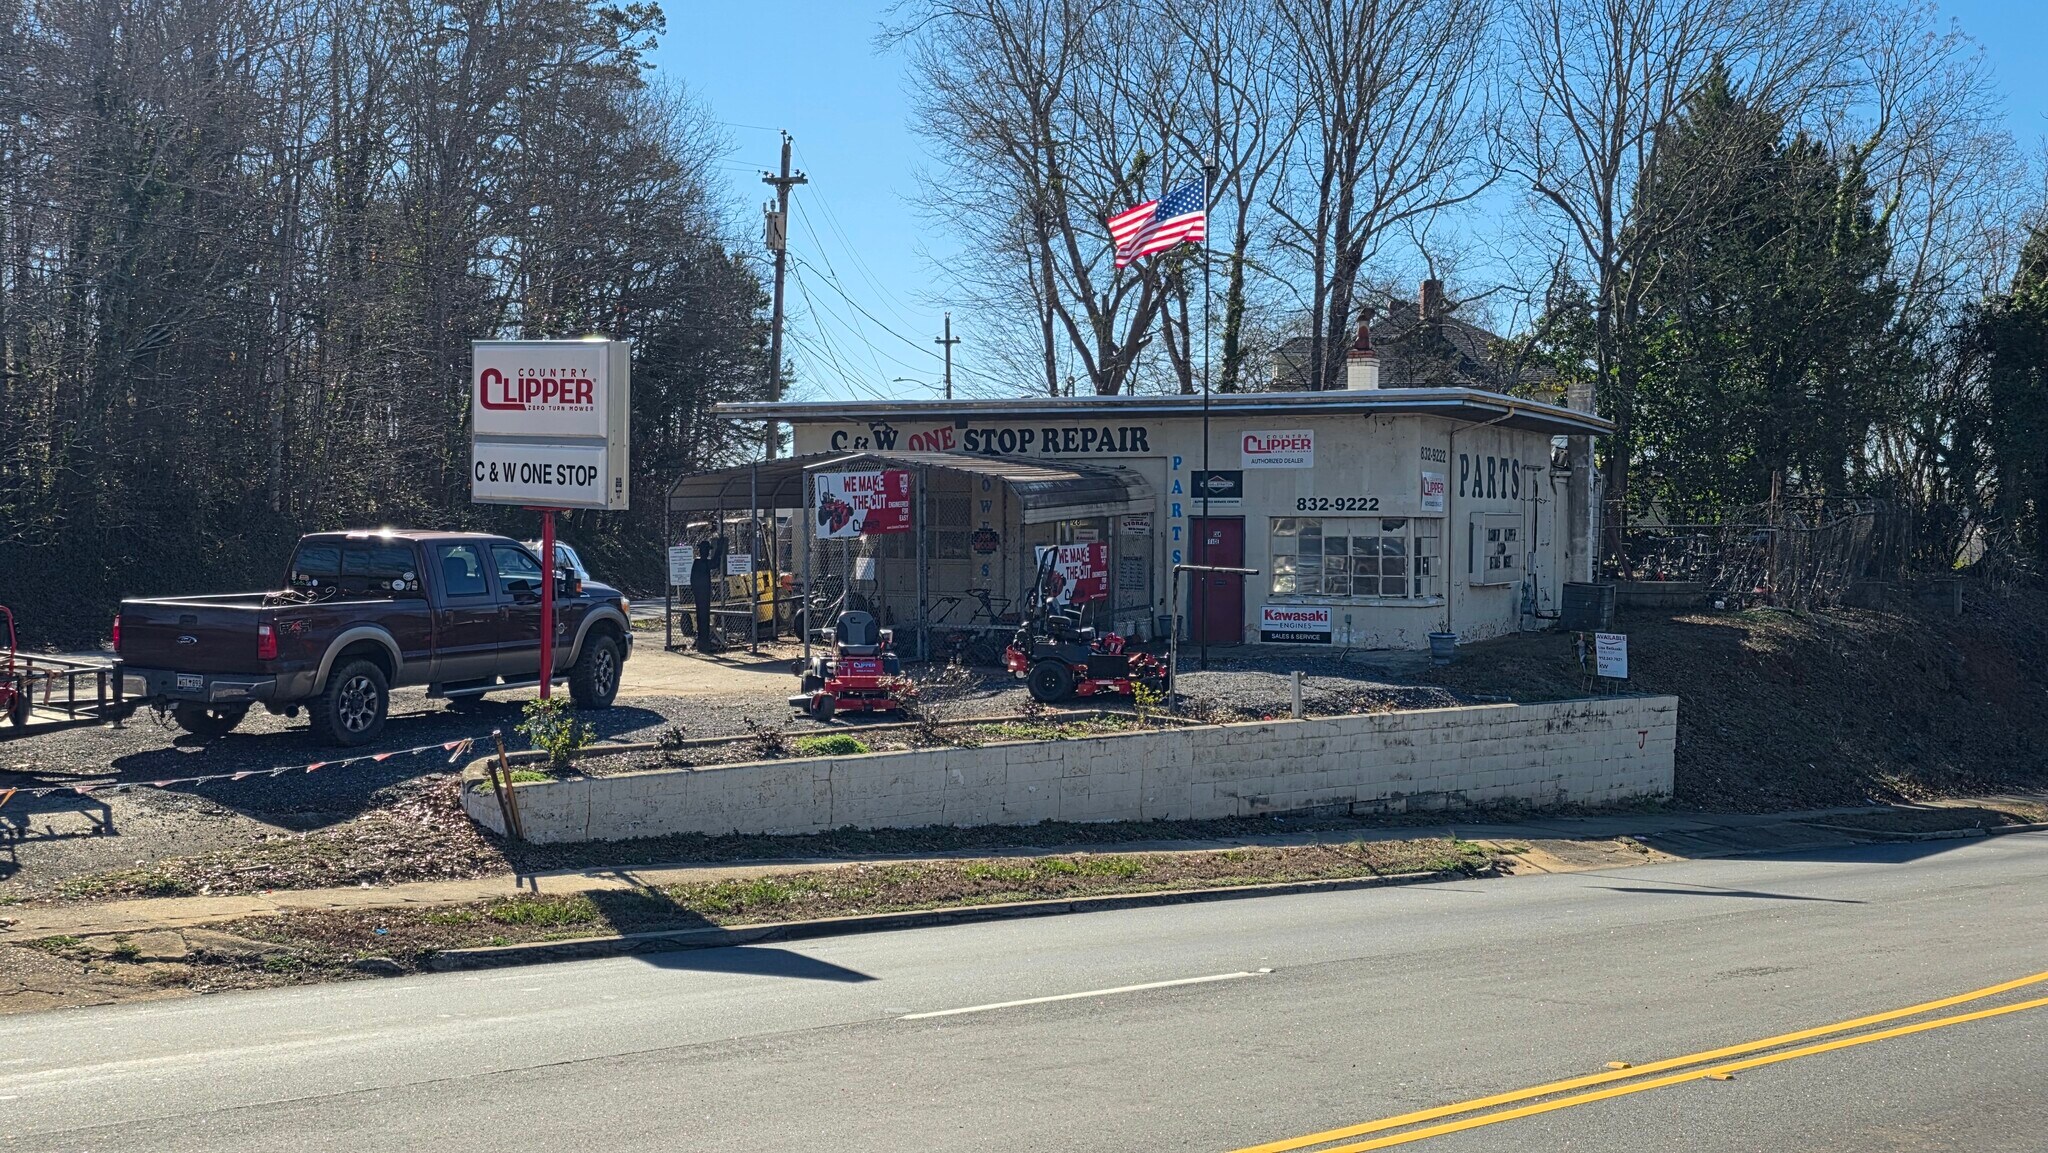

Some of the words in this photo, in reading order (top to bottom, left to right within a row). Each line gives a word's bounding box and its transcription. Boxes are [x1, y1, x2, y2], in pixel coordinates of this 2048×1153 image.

[518, 368, 588, 378] COUNTRY
[480, 368, 593, 411] CLIPPER
[831, 430, 848, 451] C
[853, 436, 869, 450] &
[873, 430, 899, 451] W
[908, 425, 956, 451] ONE
[963, 428, 1035, 454] STOP
[1041, 426, 1150, 453] REPAIR
[1243, 435, 1311, 454] CLIPPER
[1420, 446, 1446, 463] 832-9222
[474, 460, 485, 482] C
[489, 461, 499, 483] &
[503, 462, 516, 483] W
[520, 462, 552, 485] ONE
[556, 464, 598, 487] STOP
[1459, 453, 1520, 501] PARTS
[843, 475, 857, 492] WE
[858, 474, 885, 492] MAKE
[852, 495, 869, 510] THE
[870, 494, 887, 510] CUT
[1171, 455, 1183, 564] PARTS
[1296, 497, 1380, 511] 832-9222
[1070, 547, 1090, 563] MAKE
[1066, 566, 1078, 580] THE
[1264, 609, 1328, 622] Kawasaki
[1296, 633, 1321, 641] SERVICE
[1638, 730, 1648, 749] J
